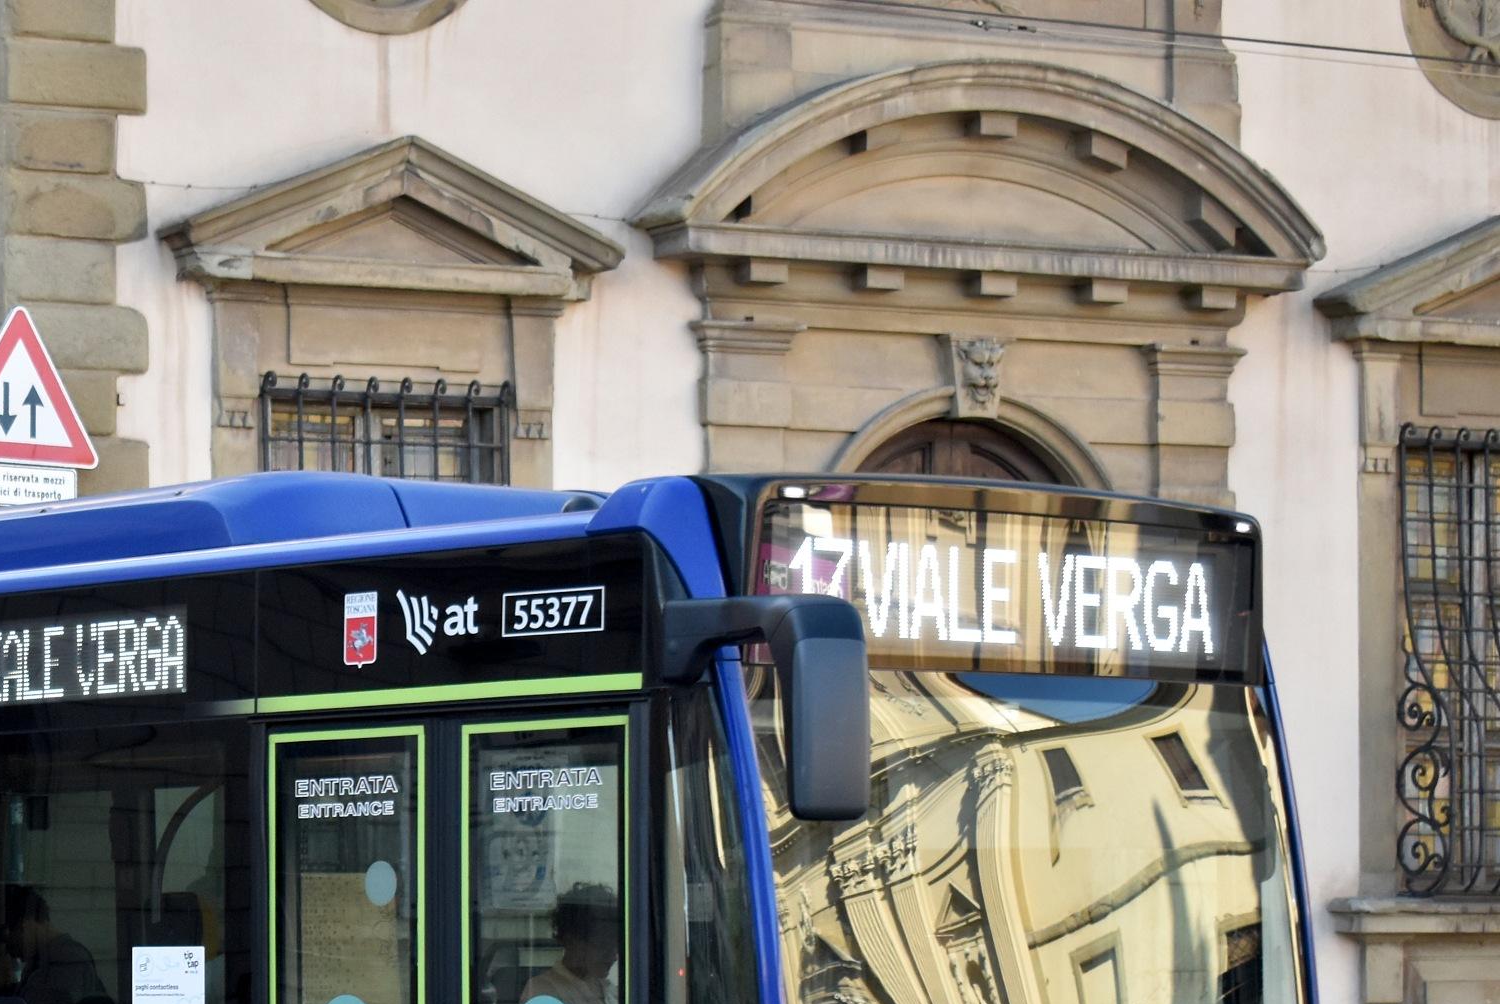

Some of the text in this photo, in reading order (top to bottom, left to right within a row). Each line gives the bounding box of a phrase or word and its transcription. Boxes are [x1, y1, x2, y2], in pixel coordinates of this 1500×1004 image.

[3, 472, 38, 483] riservata
[43, 477, 65, 485] mezzi
[14, 487, 21, 496] di
[25, 488, 61, 500] trasporto
[858, 540, 1017, 645] VIALE
[1037, 552, 1213, 654] VERGA
[443, 596, 479, 637] at
[513, 595, 594, 630] 55377
[76, 615, 184, 695] VERGA
[294, 775, 399, 798] ENTRATA
[489, 766, 603, 791] ENTRATA
[297, 800, 395, 819] ENTRANCE
[492, 793, 599, 813] ENTRANCE
